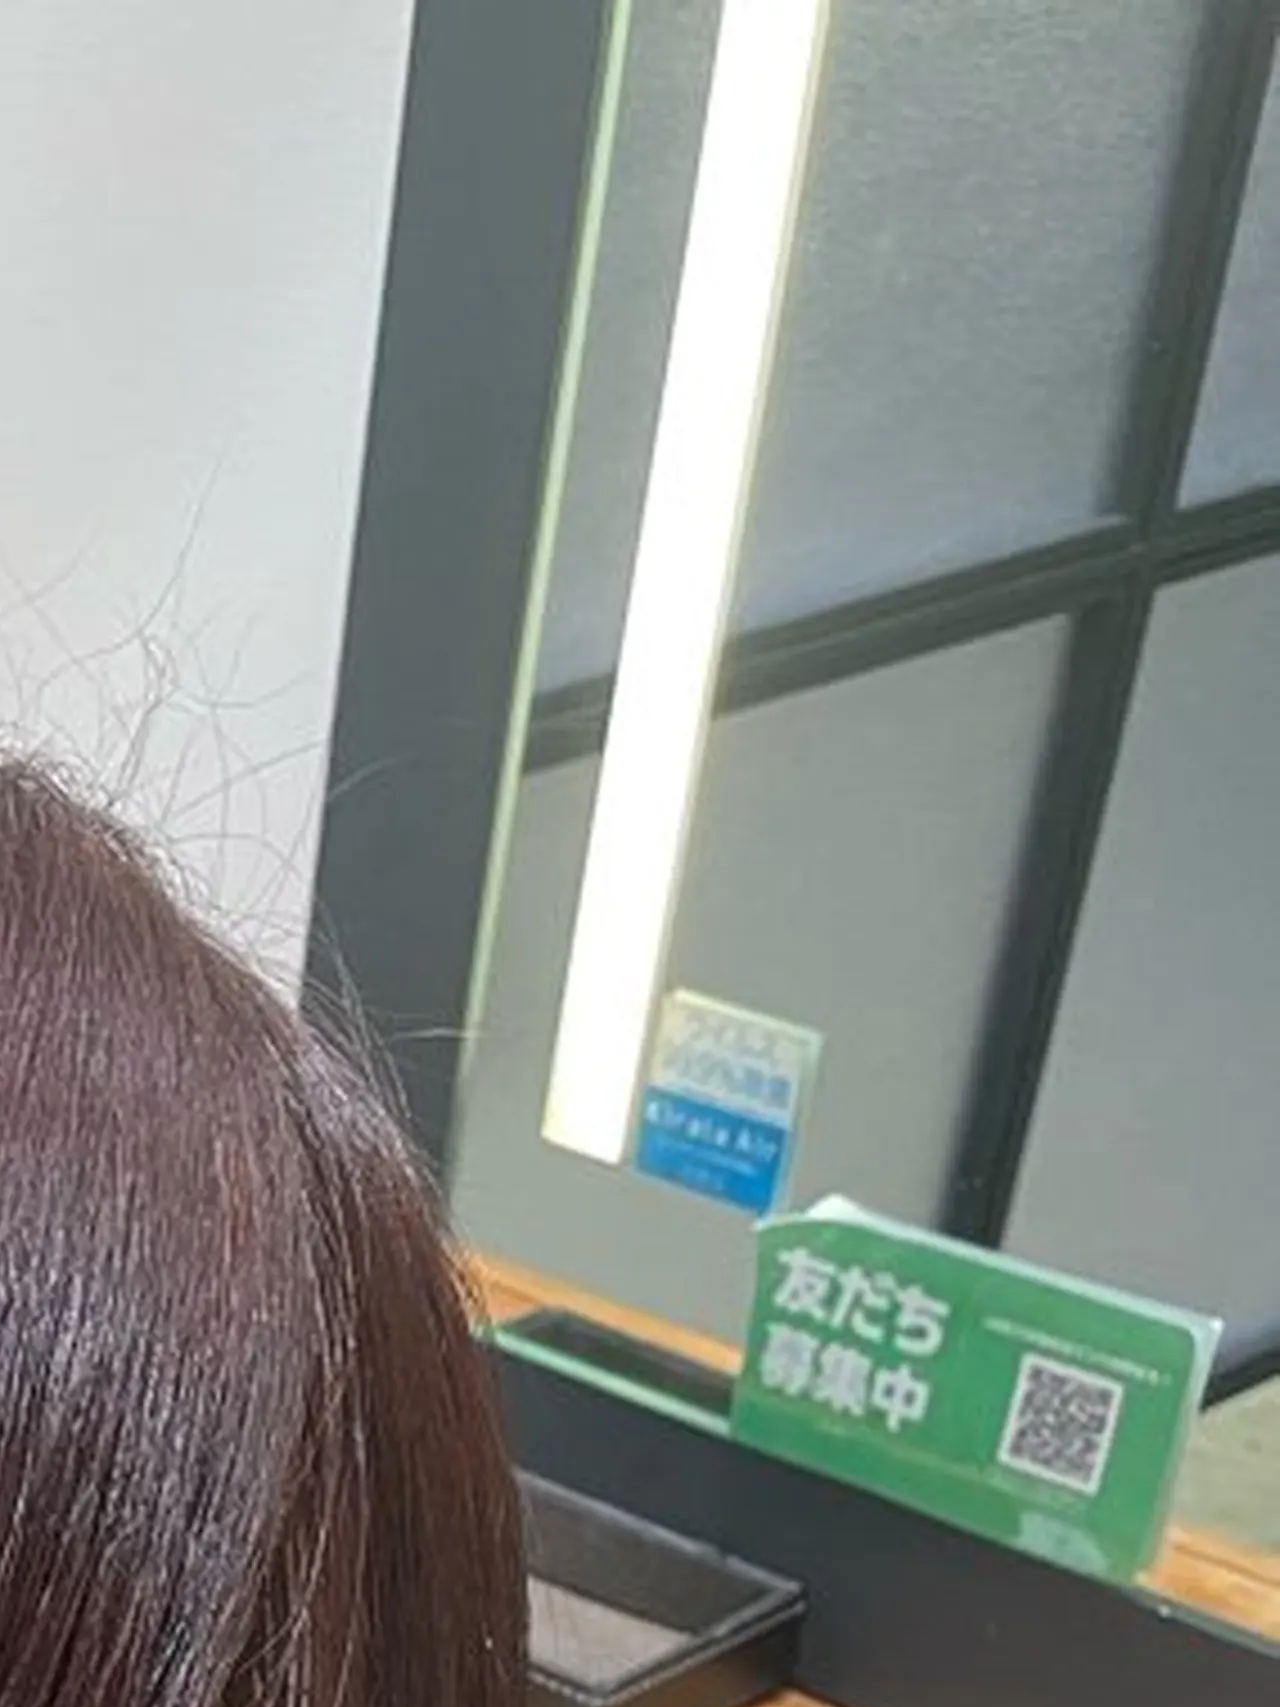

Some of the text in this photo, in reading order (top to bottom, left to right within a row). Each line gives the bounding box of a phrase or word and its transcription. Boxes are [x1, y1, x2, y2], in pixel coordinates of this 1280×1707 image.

[773, 1247, 950, 1357] 友だち
[760, 1321, 930, 1433] 募集中
